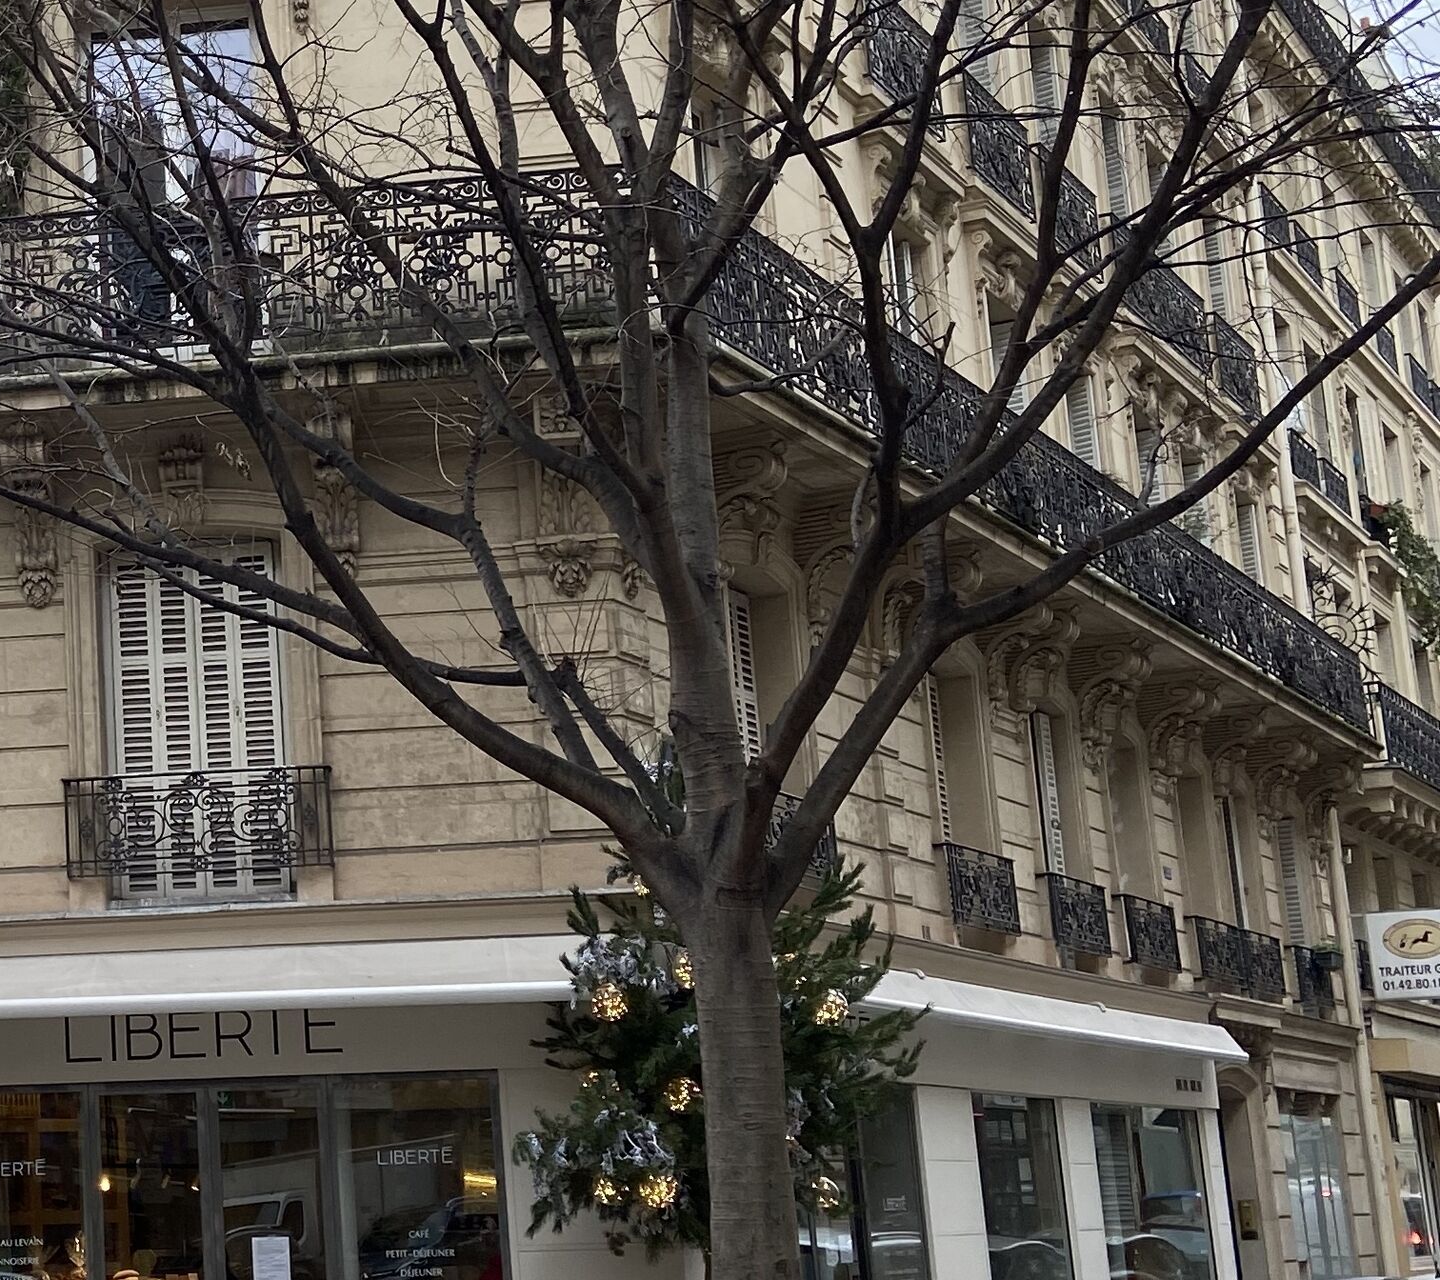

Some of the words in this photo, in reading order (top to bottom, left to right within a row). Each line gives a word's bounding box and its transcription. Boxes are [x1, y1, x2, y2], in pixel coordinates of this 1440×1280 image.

[1378, 964, 1432, 977] TRAITEUR
[408, 1229, 430, 1239] CAFÉ
[0, 1239, 13, 1247] AU
[14, 1237, 44, 1247] LEVAIN
[385, 1248, 456, 1258] PETIT-DÉJEUNER
[400, 1268, 443, 1277] DÉJEUNER
